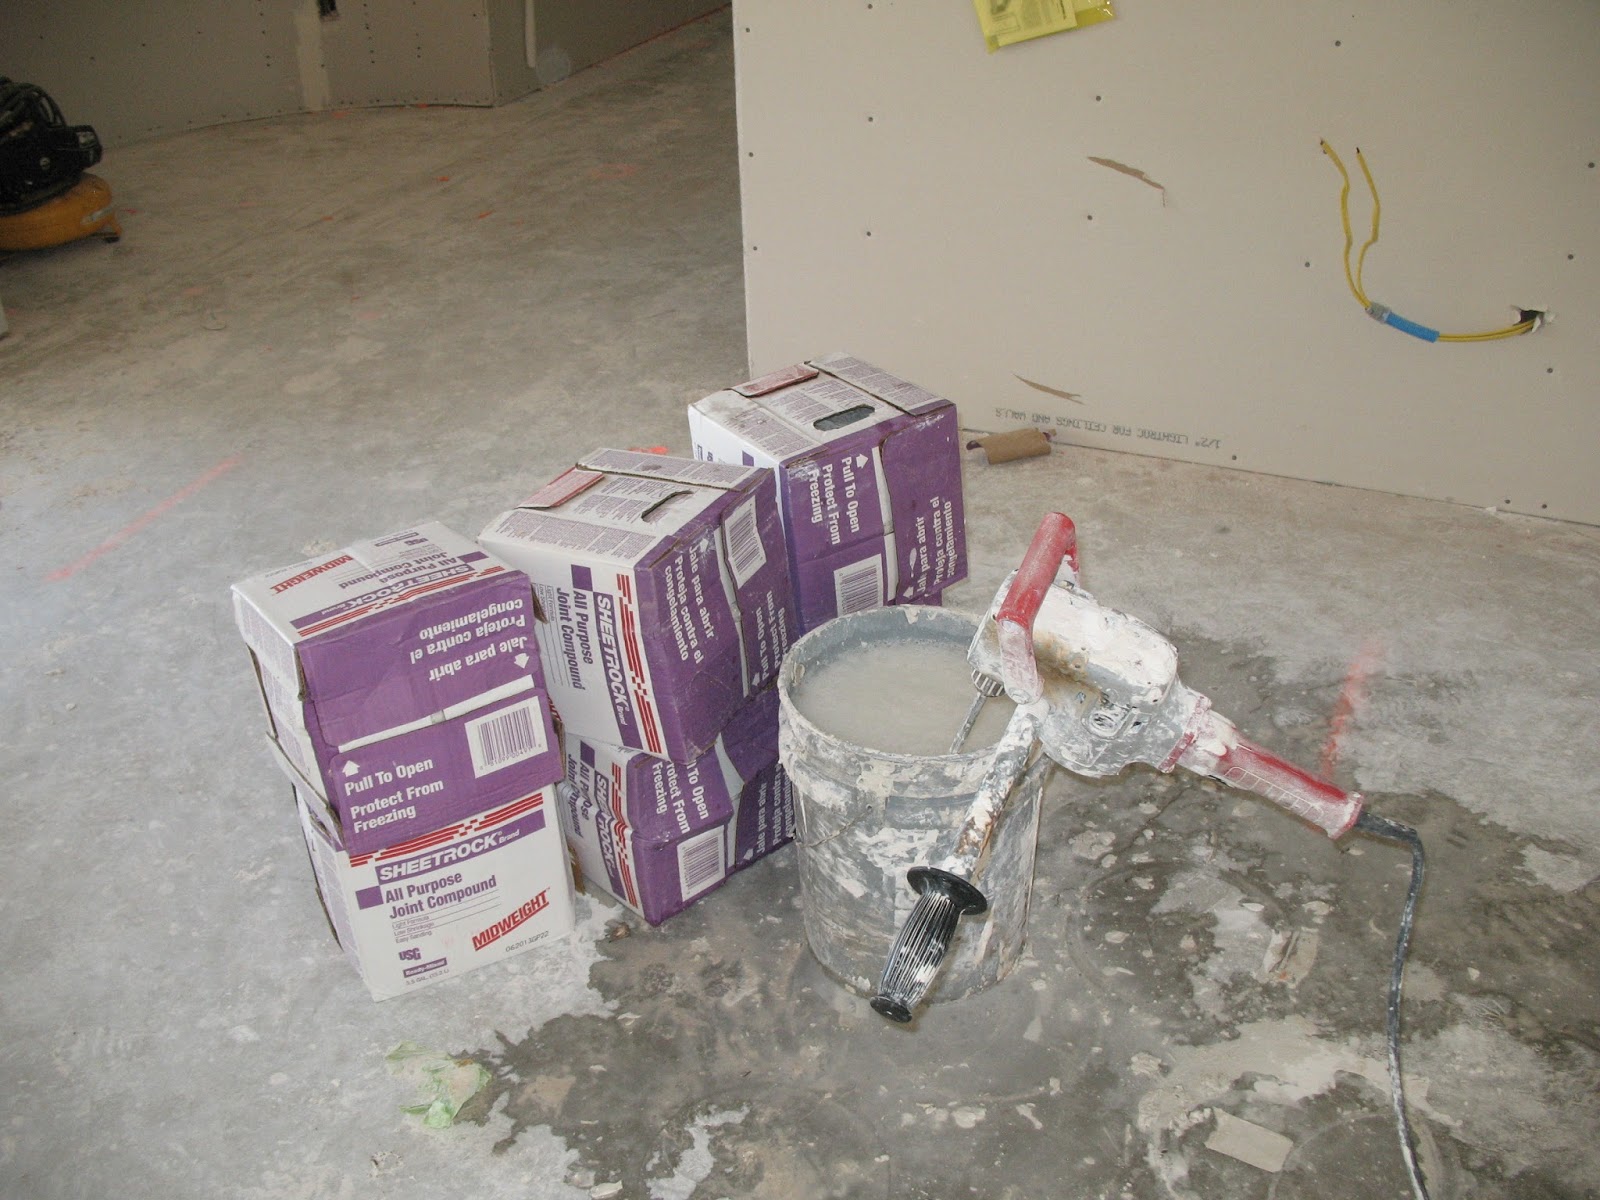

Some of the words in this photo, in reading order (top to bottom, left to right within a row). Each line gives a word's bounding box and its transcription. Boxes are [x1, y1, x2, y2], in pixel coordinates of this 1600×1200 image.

[995, 408, 1026, 421] WALLS
[1032, 413, 1051, 424] AND
[1056, 416, 1107, 432] CEILINGS
[1112, 425, 1131, 436] FOR
[841, 456, 855, 483] Pull
[807, 468, 823, 524] Freezing
[822, 463, 838, 511] Protect
[845, 482, 856, 499] To
[930, 496, 940, 509] el
[828, 511, 841, 545] From
[846, 500, 860, 533] Open
[916, 516, 926, 544] abrir
[933, 510, 944, 547] contra
[379, 562, 437, 584] Purpose
[413, 552, 449, 563] Joint
[441, 557, 458, 567] All
[689, 546, 699, 574] Jale
[919, 545, 931, 573] para
[269, 554, 354, 594] MIDWEIGHT
[338, 561, 413, 590] Compound
[348, 564, 471, 606] SHEETROCK
[675, 554, 688, 605] Proteja
[692, 574, 704, 606] para
[557, 587, 572, 622] Joint
[573, 590, 588, 610] All
[665, 565, 689, 661] congelamiento
[767, 590, 776, 625] From
[419, 598, 523, 640] congelamiento
[475, 614, 526, 638] Proteja
[680, 605, 698, 649] contra
[700, 606, 715, 639] abrir
[756, 607, 765, 640] Open
[778, 607, 788, 655] reezing
[426, 631, 472, 655] contra
[465, 643, 497, 666] para
[499, 636, 528, 653] Jale
[576, 612, 593, 665] Purpose
[760, 640, 767, 657] To
[770, 623, 781, 669] Protect
[409, 648, 424, 665] el
[428, 659, 462, 682] abrir
[562, 624, 586, 690] Compound
[597, 595, 628, 705] SHEETROCK
[616, 705, 628, 726] Brand
[694, 650, 704, 664] el
[761, 655, 770, 681] Pull
[344, 775, 374, 796] Pull
[375, 771, 393, 785] To
[395, 759, 434, 779] Open
[580, 762, 590, 782] All
[652, 761, 668, 815] Freezing
[666, 762, 681, 800] rotect
[687, 768, 699, 785] To
[350, 790, 404, 820] Protect
[406, 780, 444, 801] From
[692, 786, 709, 820] Open
[773, 772, 781, 807] contra
[353, 805, 416, 834] Freezing
[673, 799, 691, 834] From
[758, 806, 767, 832] para
[772, 806, 783, 846] Proteja
[379, 832, 498, 881] SHEETROCK
[499, 829, 520, 843] Brand
[756, 831, 766, 854] Jale
[385, 888, 403, 904] All
[407, 872, 463, 898] Purpose
[389, 899, 425, 920] Joint
[427, 875, 497, 909] Compound
[392, 920, 406, 930] Light
[472, 890, 548, 950] MIDWEIGHT
[398, 947, 422, 961] USG
